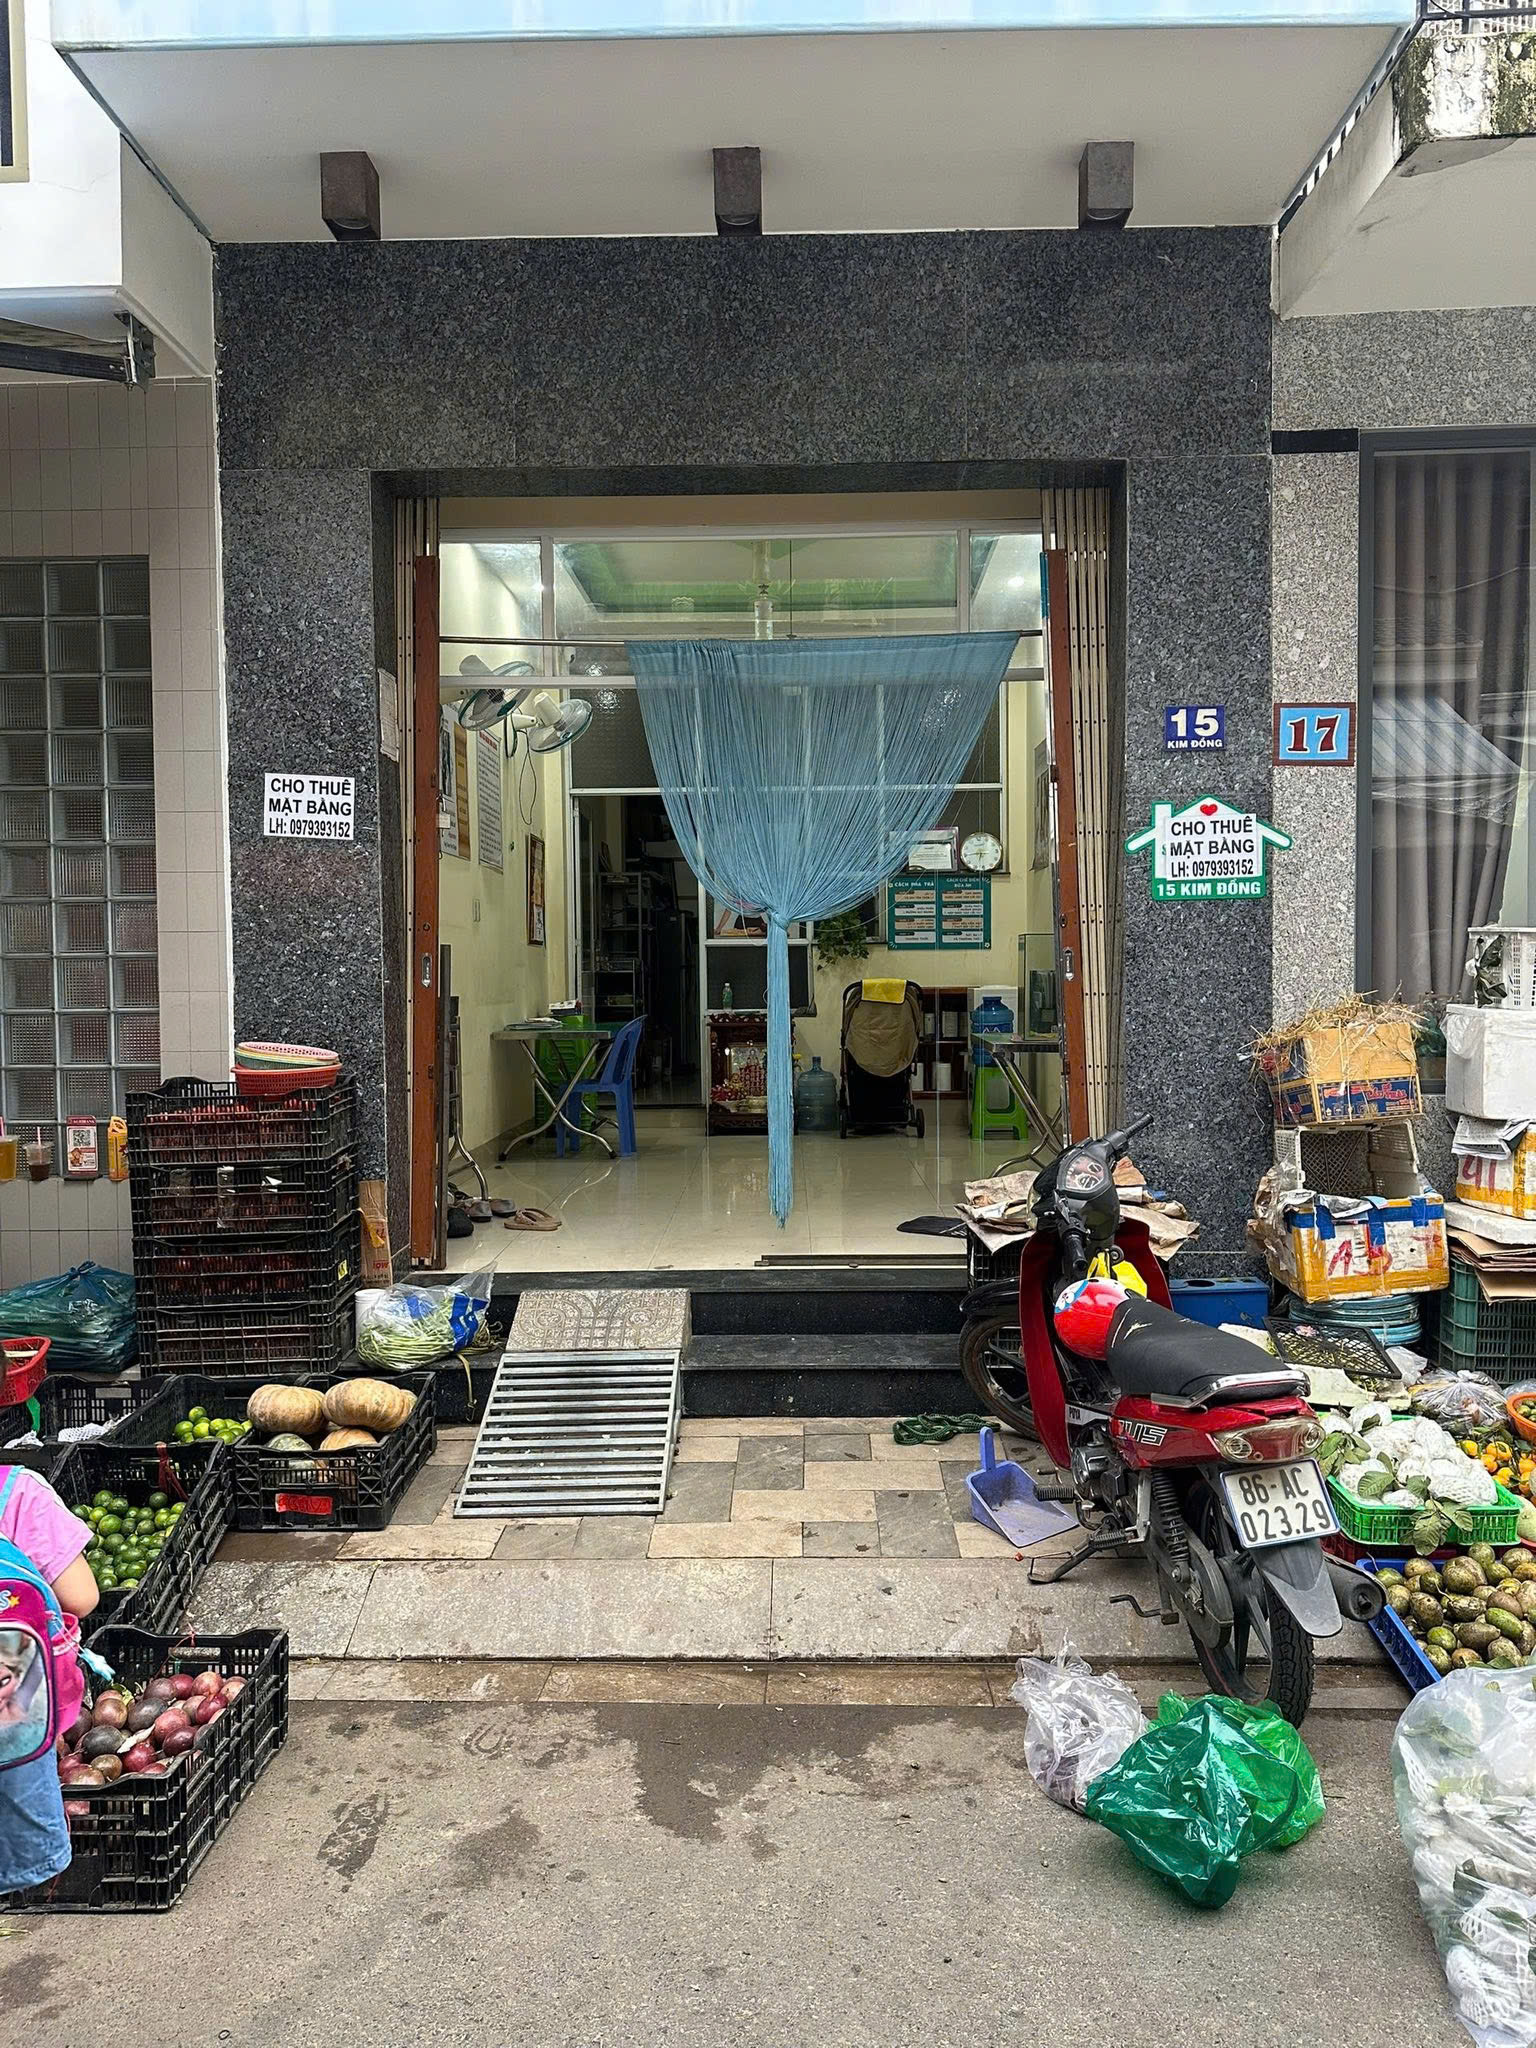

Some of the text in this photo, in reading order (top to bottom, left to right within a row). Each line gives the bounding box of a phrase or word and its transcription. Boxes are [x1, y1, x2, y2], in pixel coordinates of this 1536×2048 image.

[1171, 708, 1219, 737] 15
[1286, 713, 1342, 754] 17
[1167, 740, 1188, 749] KIM
[271, 778, 351, 796] CHO THUÊ
[269, 797, 352, 816] MẶT BẰNG
[269, 817, 350, 838] LH: 0979393152
[1171, 815, 1253, 836] CHO THUÊ
[1170, 840, 1204, 859] MẶT
[1208, 837, 1255, 855] BẰNG
[1171, 859, 1254, 878] LH: 0979393152
[1157, 883, 1176, 897] 15
[1180, 882, 1212, 896] KIM
[1238, 1466, 1309, 1506] 86-AC
[1240, 1499, 1331, 1542] 023.29
